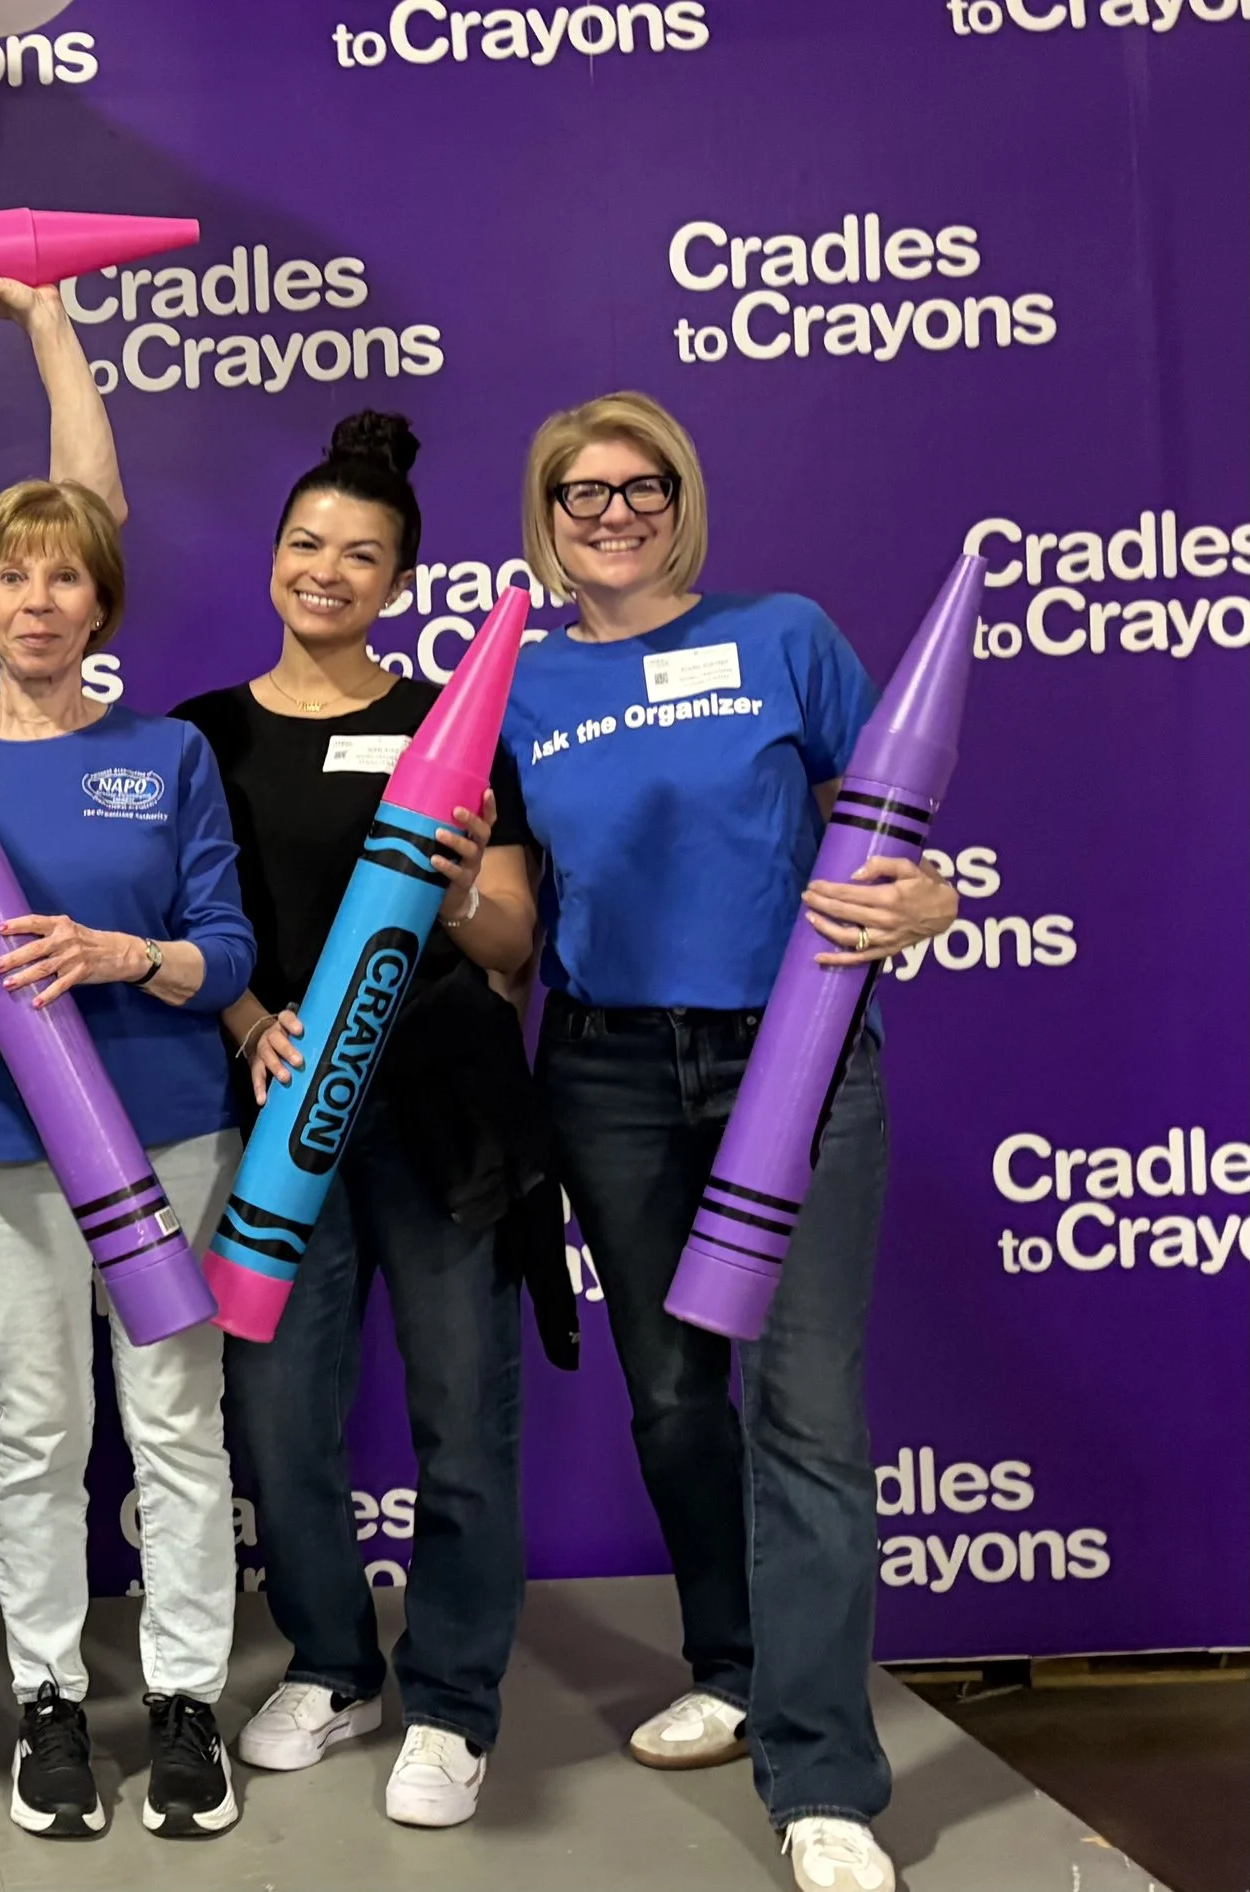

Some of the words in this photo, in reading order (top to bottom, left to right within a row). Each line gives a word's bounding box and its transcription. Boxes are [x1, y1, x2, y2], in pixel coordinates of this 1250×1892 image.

[332, 24, 387, 67] to
[389, 0, 710, 66] Crayons
[59, 244, 368, 324] Cradles
[669, 213, 981, 291] Cradles
[89, 360, 119, 395] o
[122, 323, 444, 393] Crayons
[674, 319, 728, 363] to
[731, 290, 1057, 362] Crayons
[1026, 586, 1250, 658] Crayo
[532, 730, 570, 766] Ask
[576, 716, 617, 744] the
[624, 692, 763, 729] Organizer
[98, 777, 147, 796] NAPO
[300, 946, 410, 1156] CRAYON
[993, 1126, 1250, 1203] Cradle
[997, 1229, 1053, 1274] to
[1056, 1202, 1250, 1275] Cray
[880, 1528, 1111, 1593] ayons
